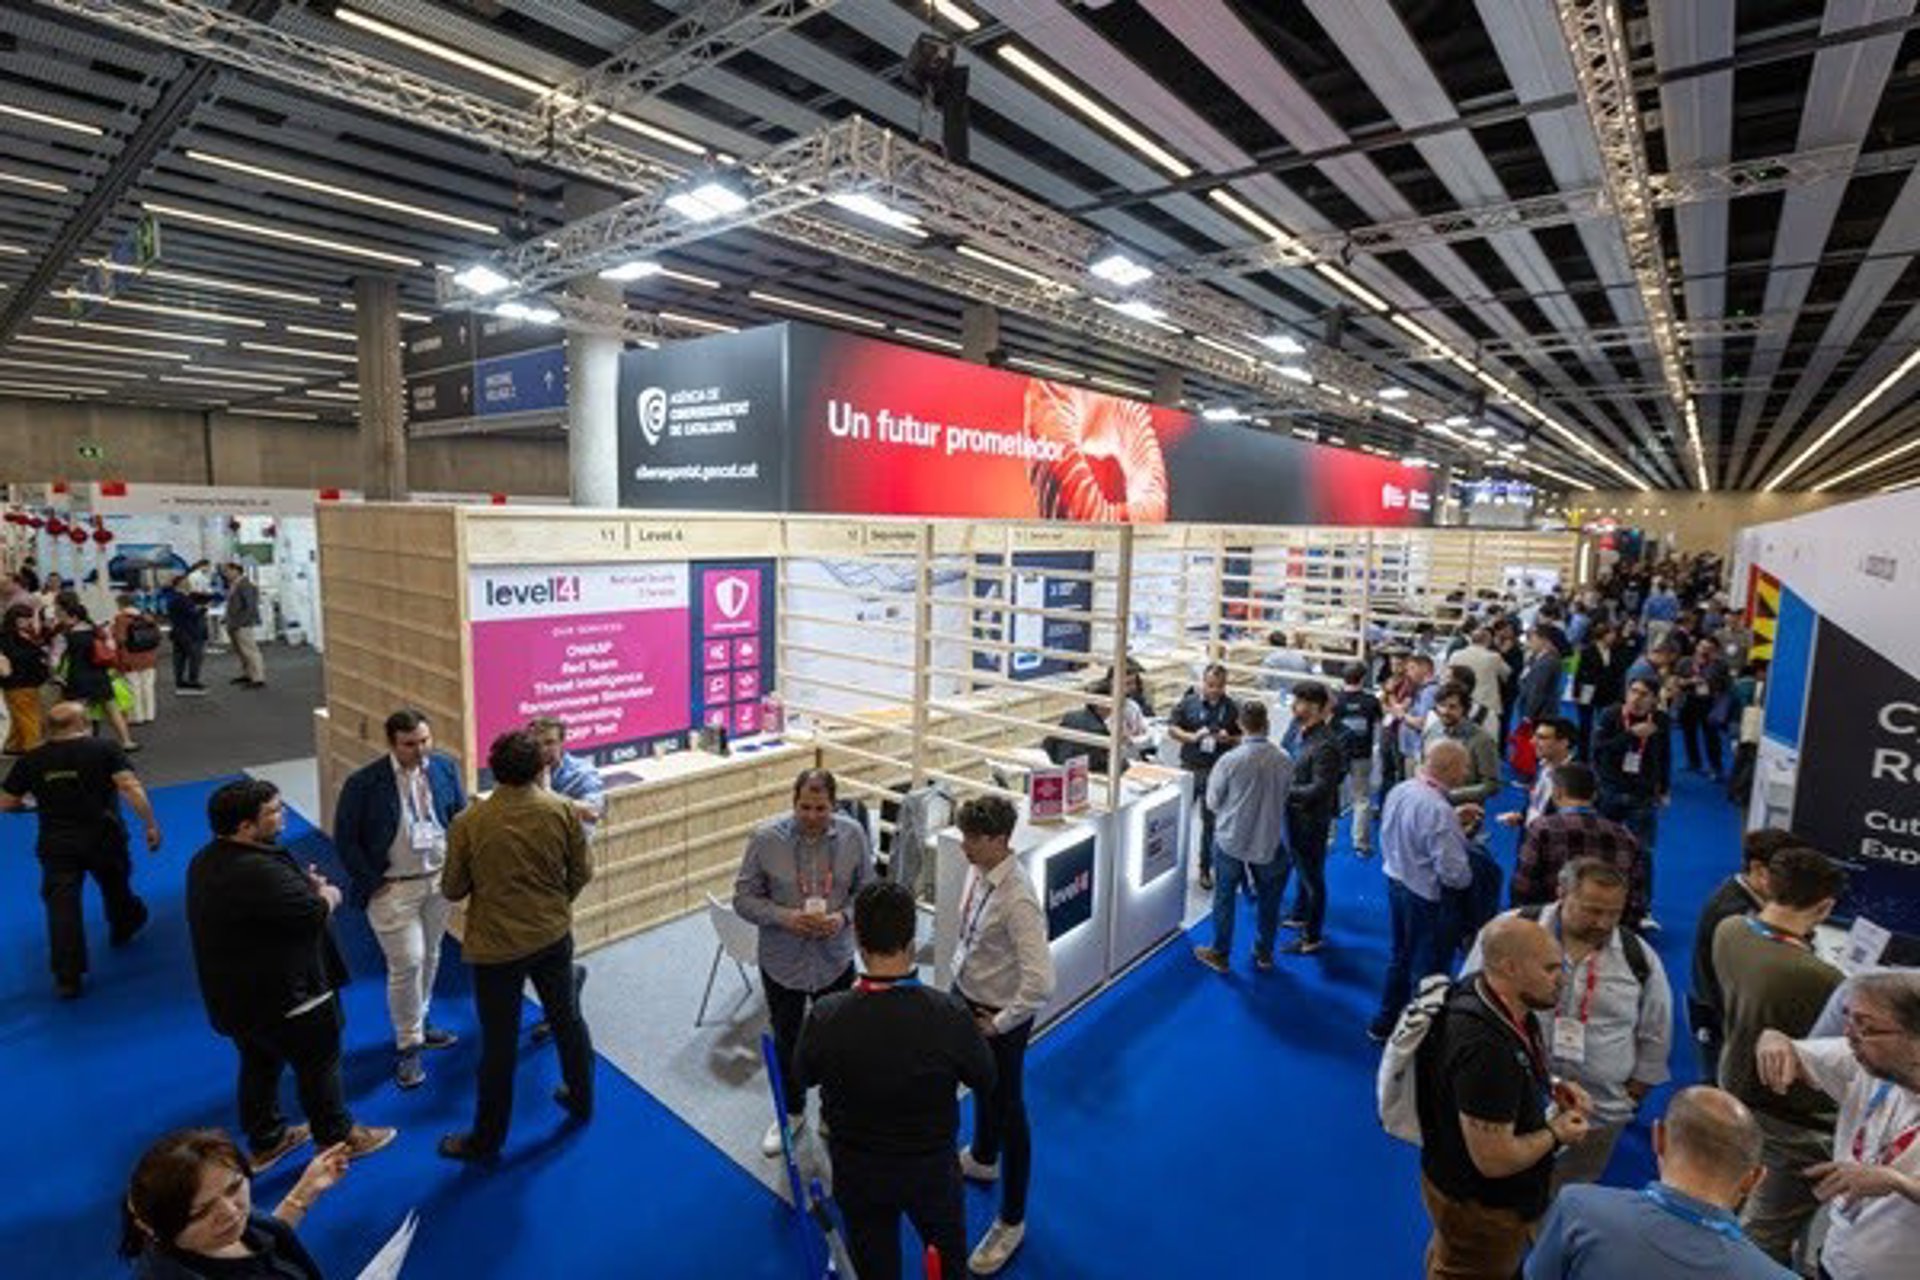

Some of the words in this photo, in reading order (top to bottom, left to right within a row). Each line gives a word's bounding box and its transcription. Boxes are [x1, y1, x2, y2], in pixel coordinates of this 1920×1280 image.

[827, 399, 870, 440] Un
[876, 408, 941, 447] futur
[946, 424, 1065, 461] prometedor
[562, 661, 586, 674] Red
[588, 658, 618, 672] Team
[534, 679, 574, 696] Threat
[1877, 702, 1920, 744] C
[1871, 746, 1920, 784] R
